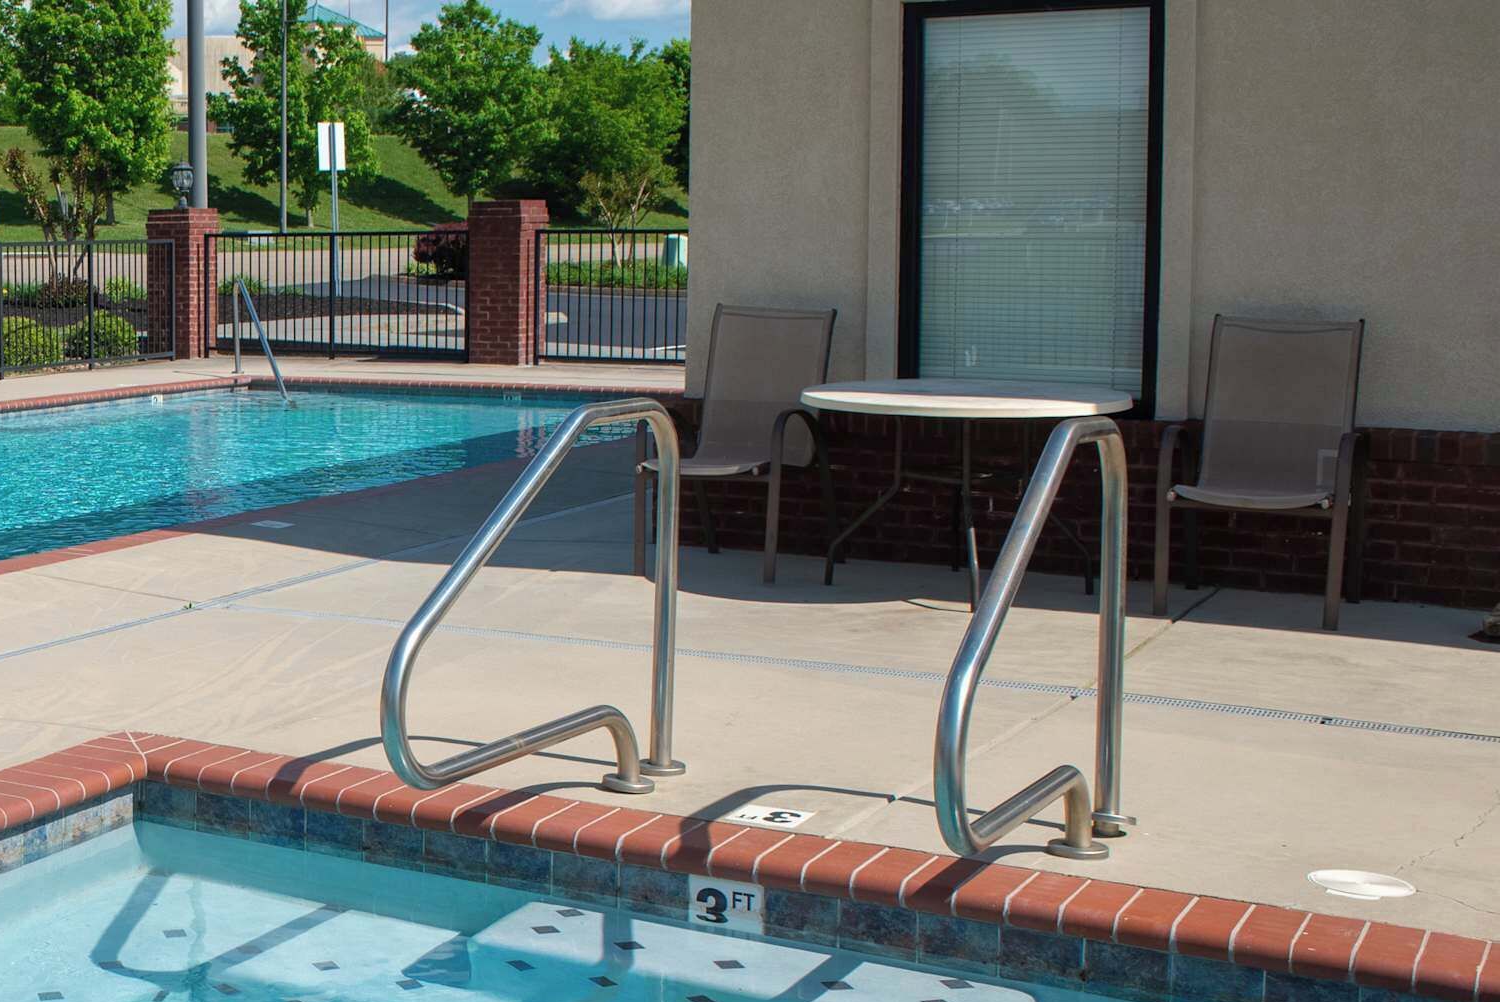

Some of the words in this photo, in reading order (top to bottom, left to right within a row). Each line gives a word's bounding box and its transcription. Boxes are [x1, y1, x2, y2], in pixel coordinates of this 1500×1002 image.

[762, 811, 801, 823] 3
[696, 887, 729, 923] 3
[732, 891, 755, 911] FT
